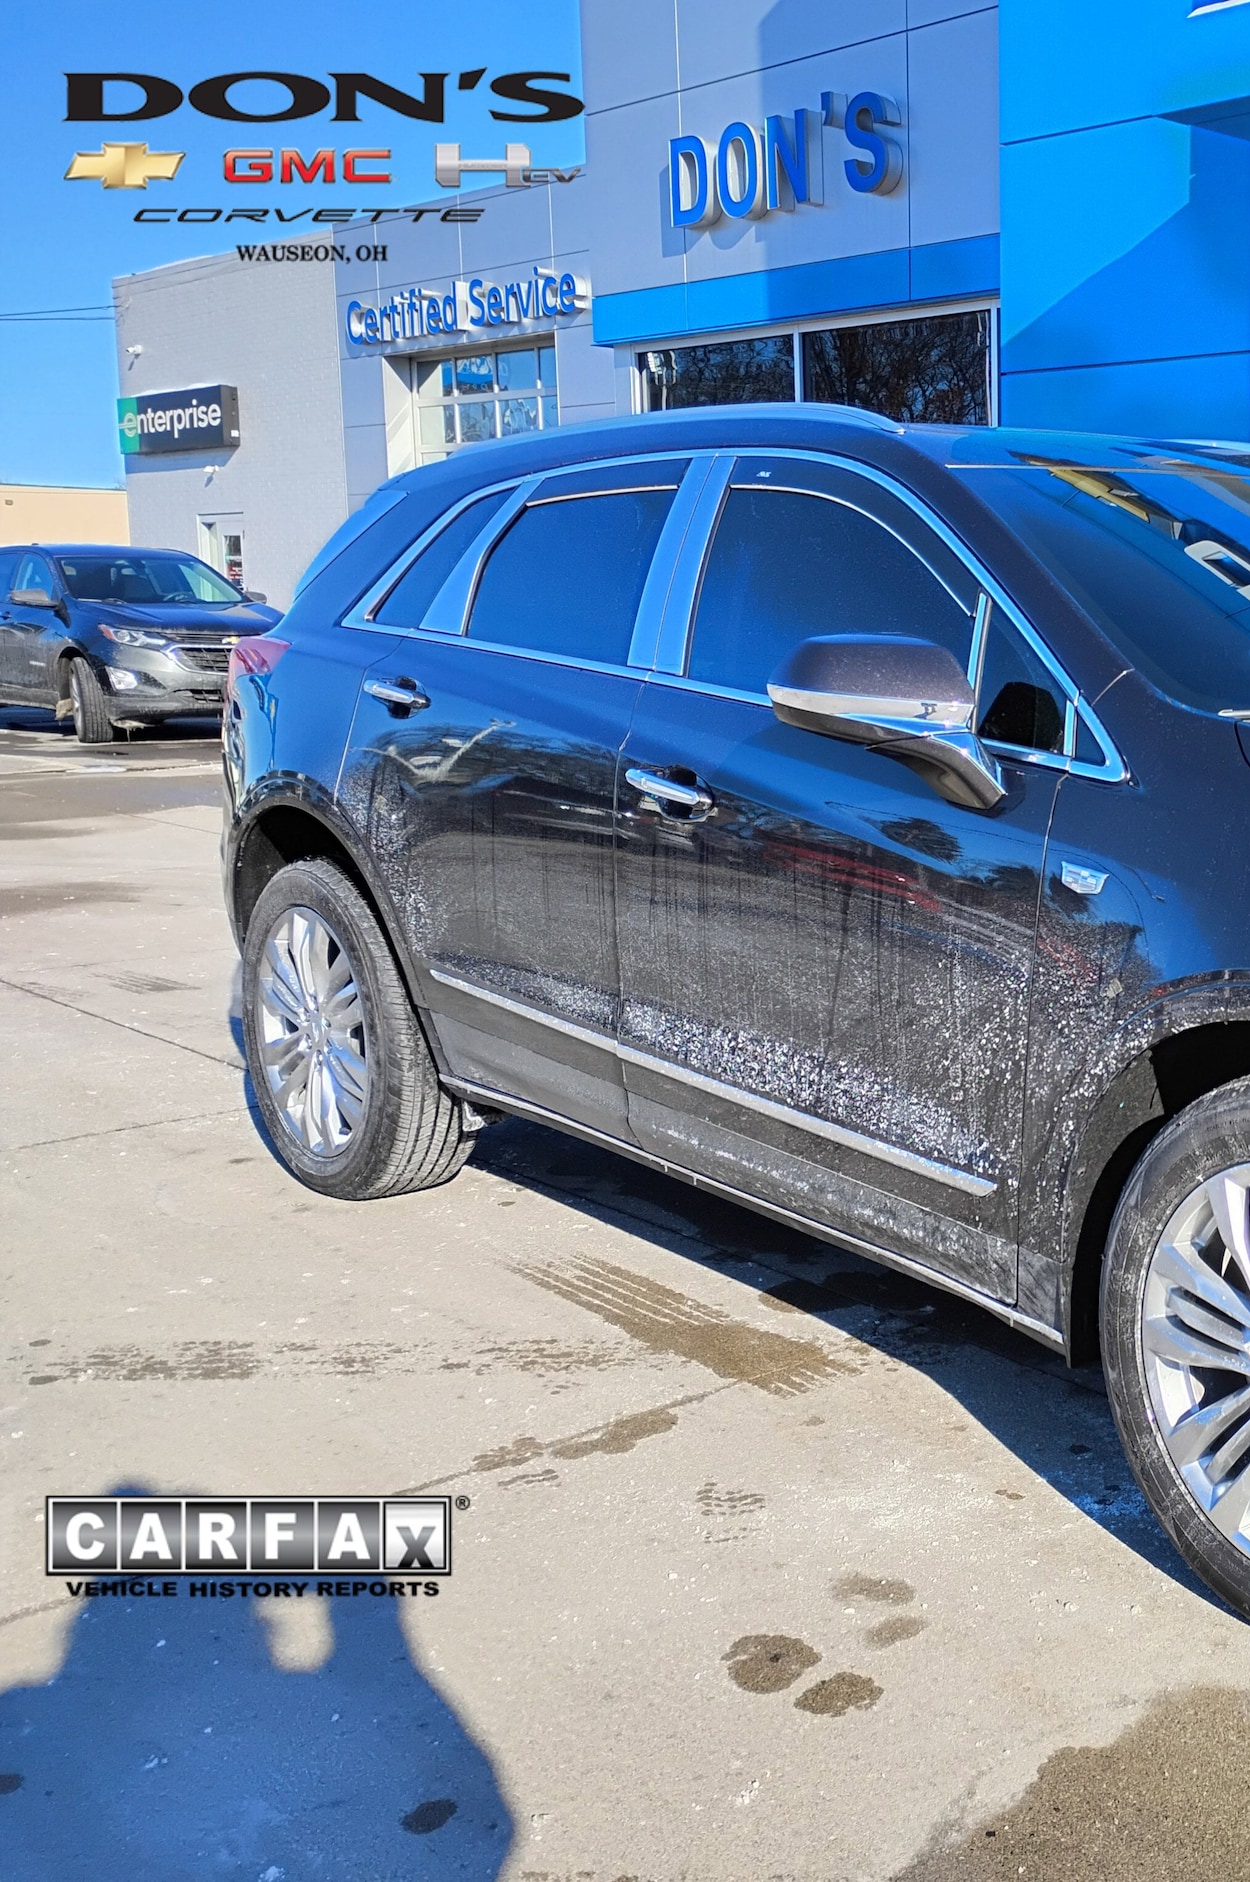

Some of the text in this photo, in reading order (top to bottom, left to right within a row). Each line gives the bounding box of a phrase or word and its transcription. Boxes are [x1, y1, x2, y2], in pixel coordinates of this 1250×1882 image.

[668, 90, 902, 229] DON'S
[346, 266, 579, 346] Certified Service
[123, 399, 222, 438] enterprise
